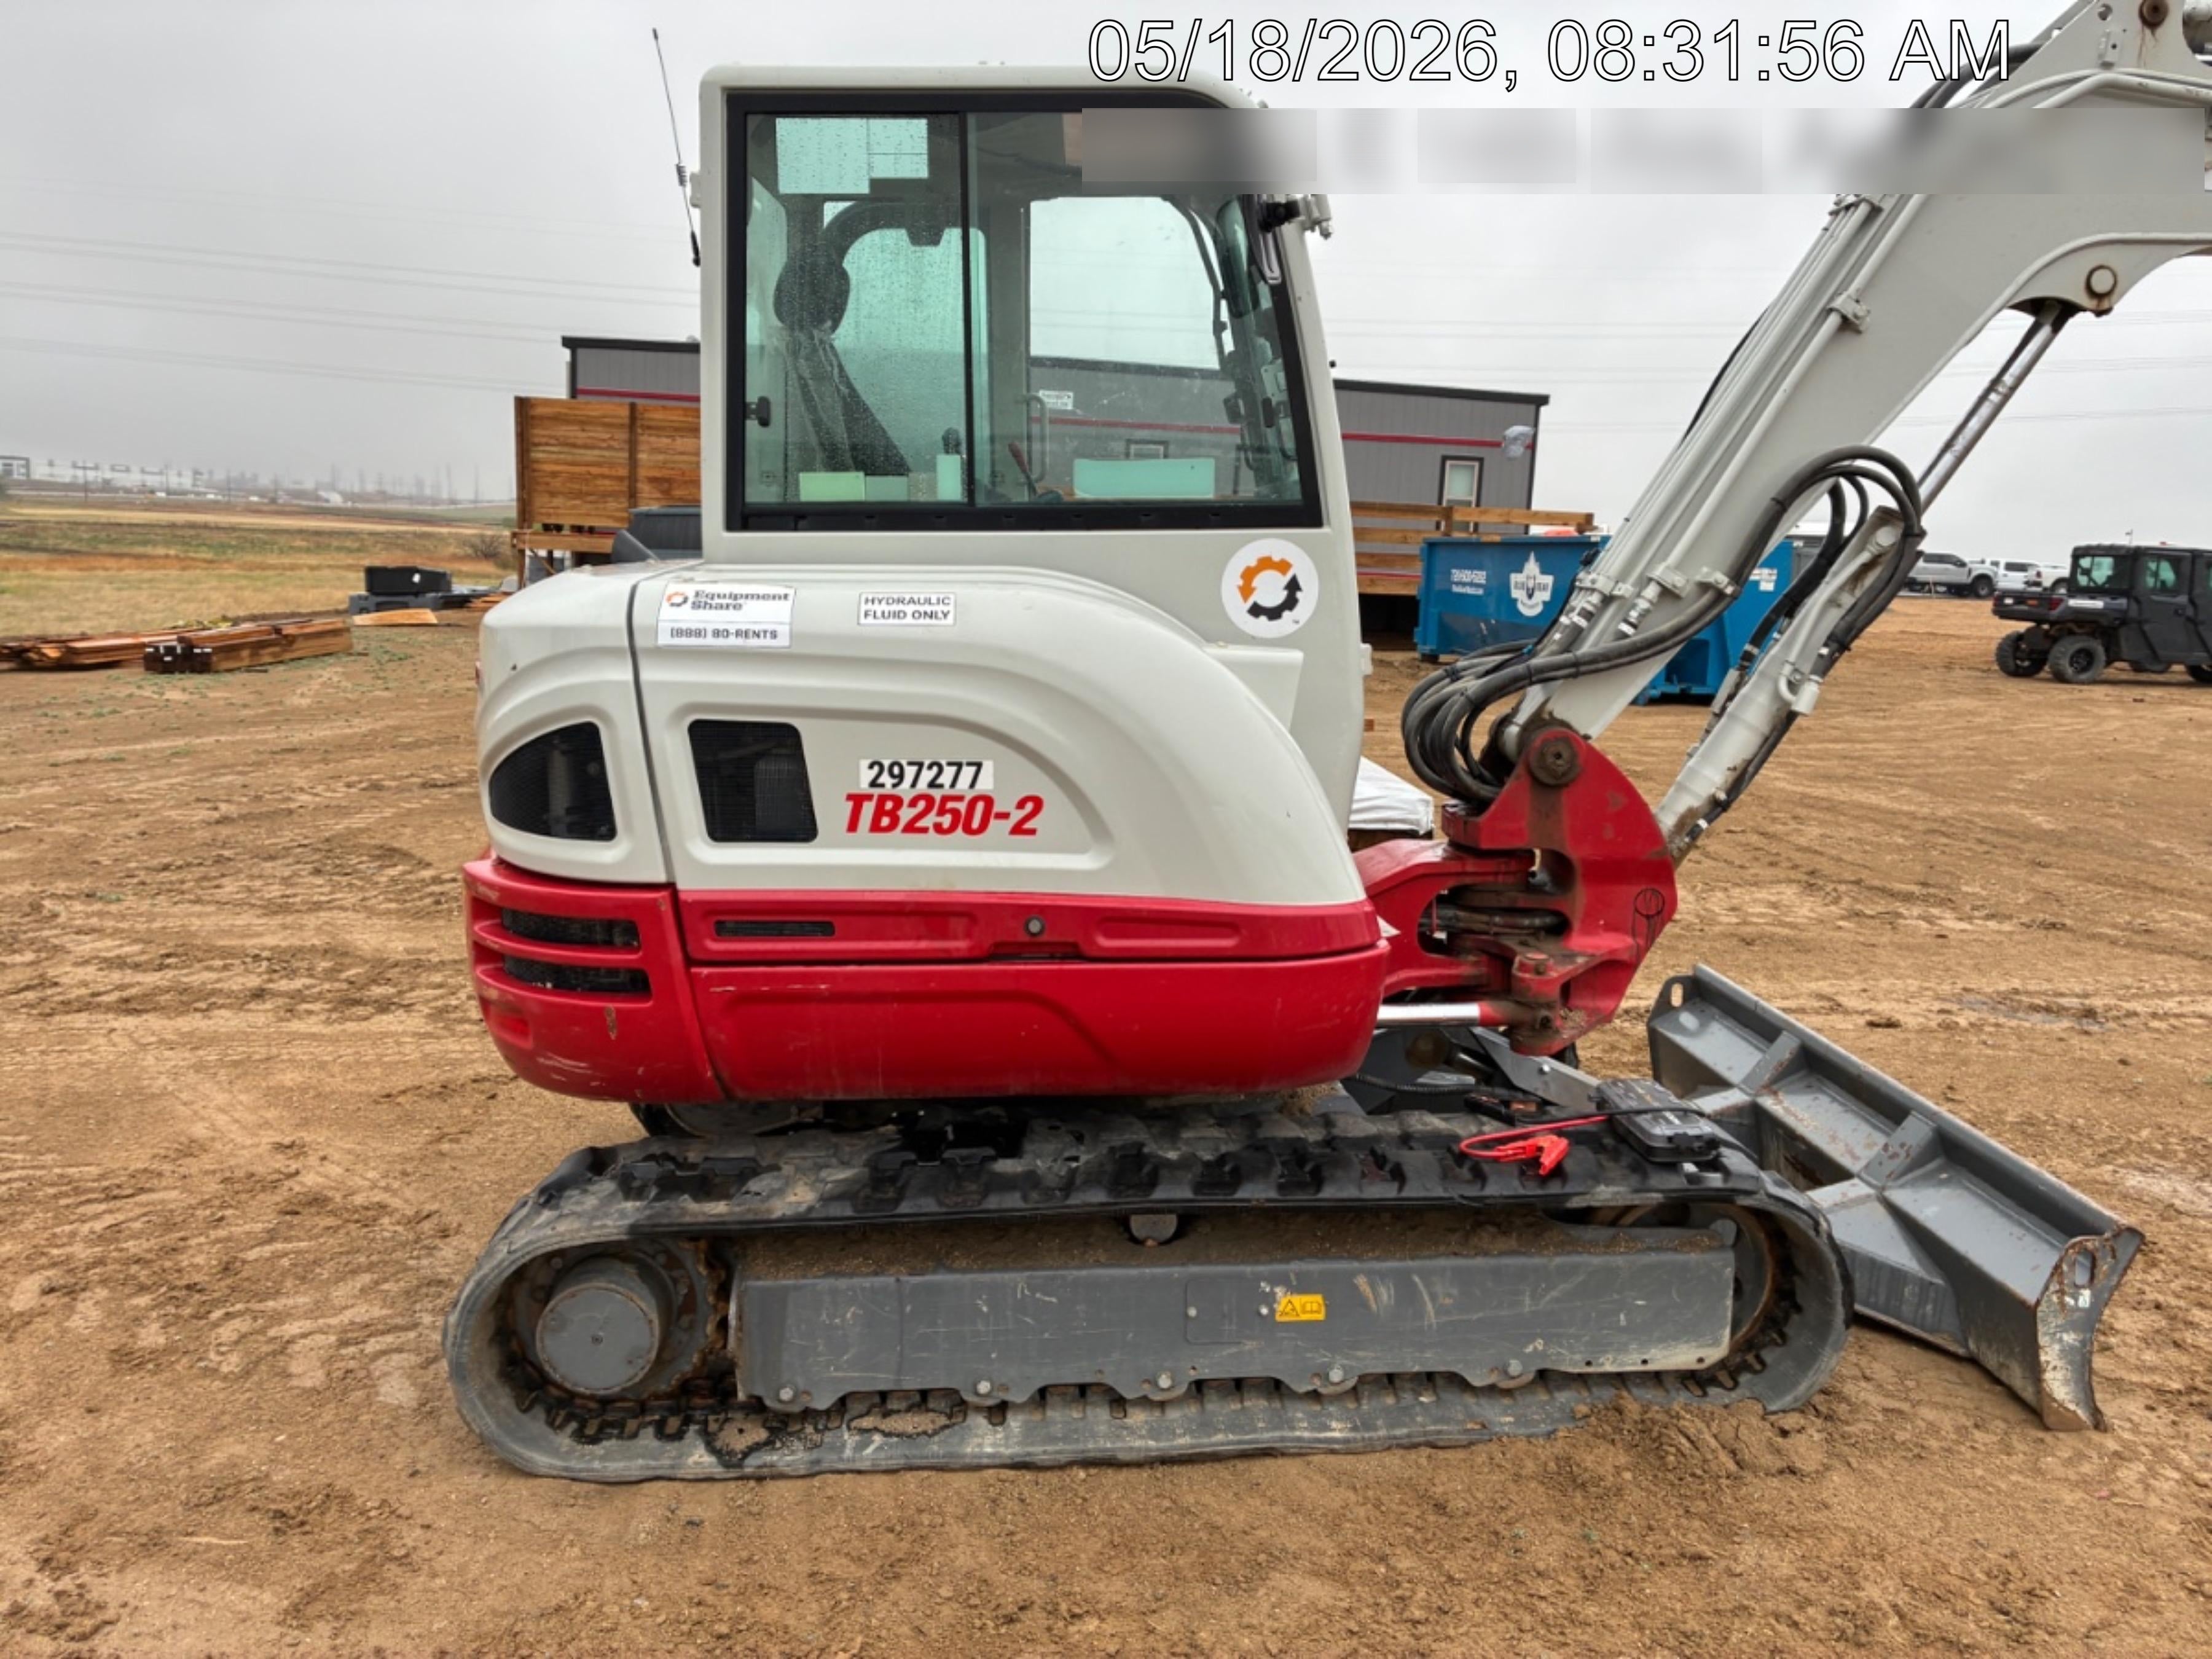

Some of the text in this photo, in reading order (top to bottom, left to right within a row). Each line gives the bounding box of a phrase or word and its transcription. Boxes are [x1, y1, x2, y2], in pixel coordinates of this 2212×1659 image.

[694, 589, 790, 602] Equipment
[864, 596, 951, 605] HYDRAULIC
[691, 600, 743, 611] Share
[864, 610, 951, 620] FLUID ONLY
[712, 628, 779, 640] 80-RENTS
[867, 760, 984, 790] 297277
[845, 793, 1045, 836] TB250-2
